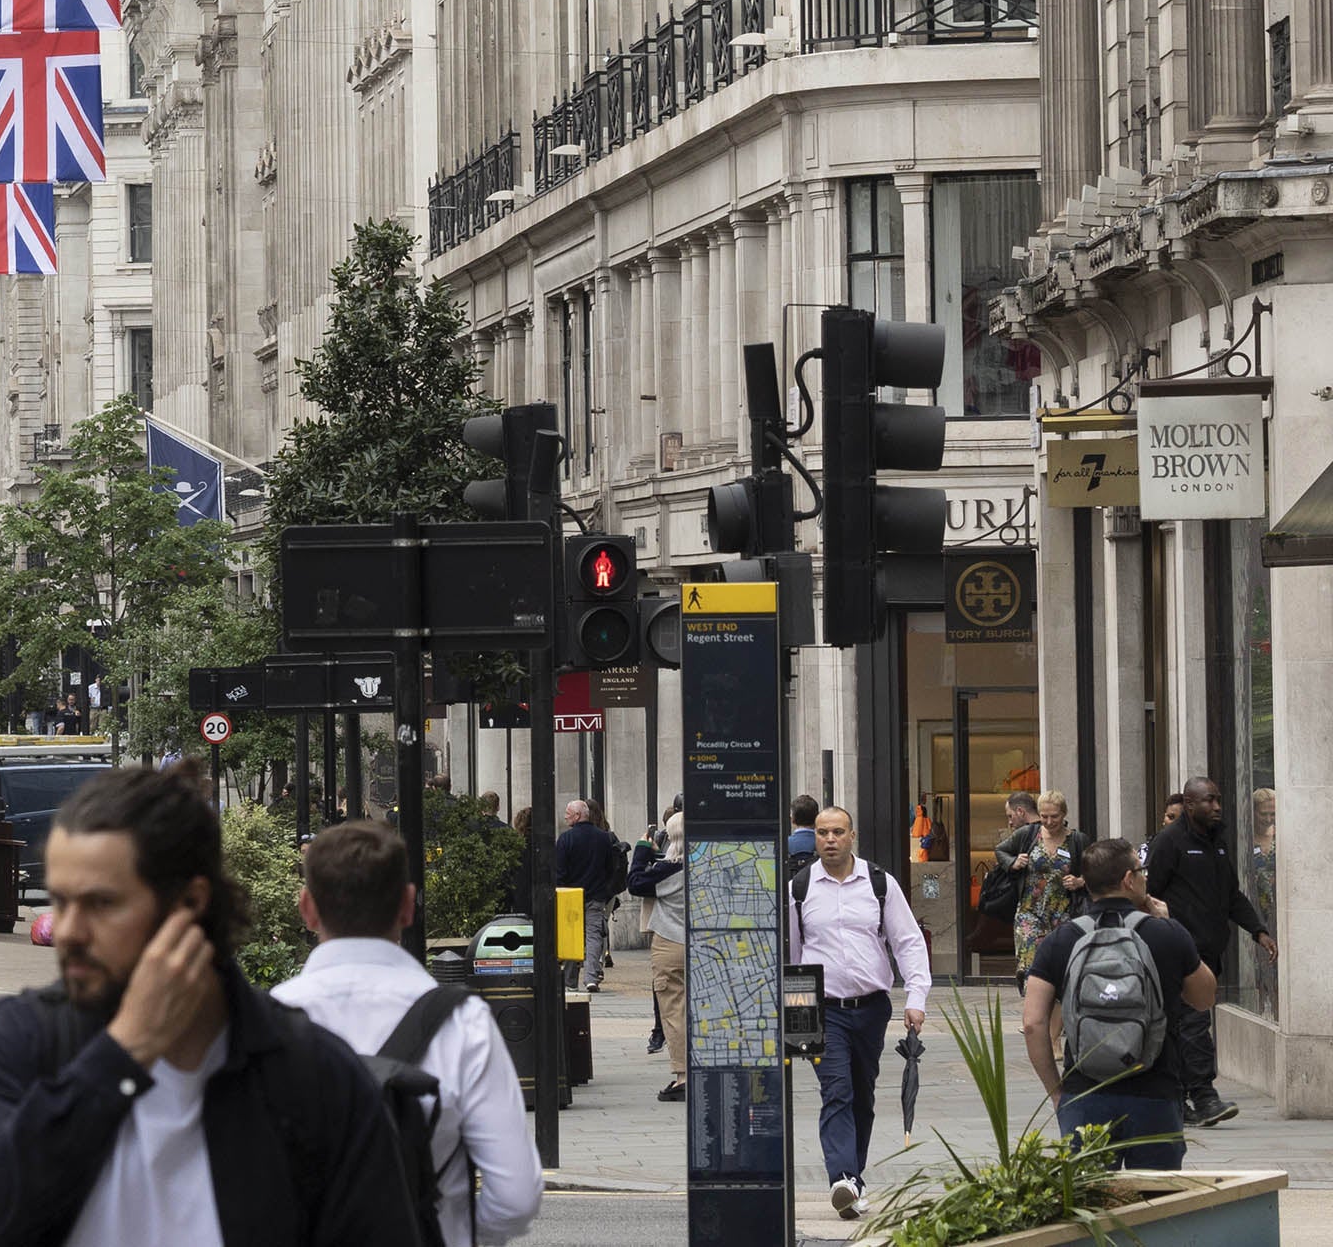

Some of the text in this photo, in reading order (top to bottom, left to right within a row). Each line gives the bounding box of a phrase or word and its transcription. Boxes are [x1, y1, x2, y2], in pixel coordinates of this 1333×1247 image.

[1149, 423, 1252, 449] MOLTON
[1151, 453, 1251, 479] BROWN
[1171, 482, 1235, 493] LONDON
[946, 498, 1036, 530] URL
[687, 622, 739, 632] WEST END
[687, 633, 755, 645] Regent Street
[949, 628, 1031, 640] TORY BURCH
[601, 666, 639, 675] ARKER
[205, 721, 228, 735] 20
[554, 713, 603, 731] TUMI
[696, 740, 753, 749] Piccadilly Circus
[696, 762, 724, 771] Carnaby
[743, 783, 766, 791] Square
[786, 993, 815, 1006] WAIT
